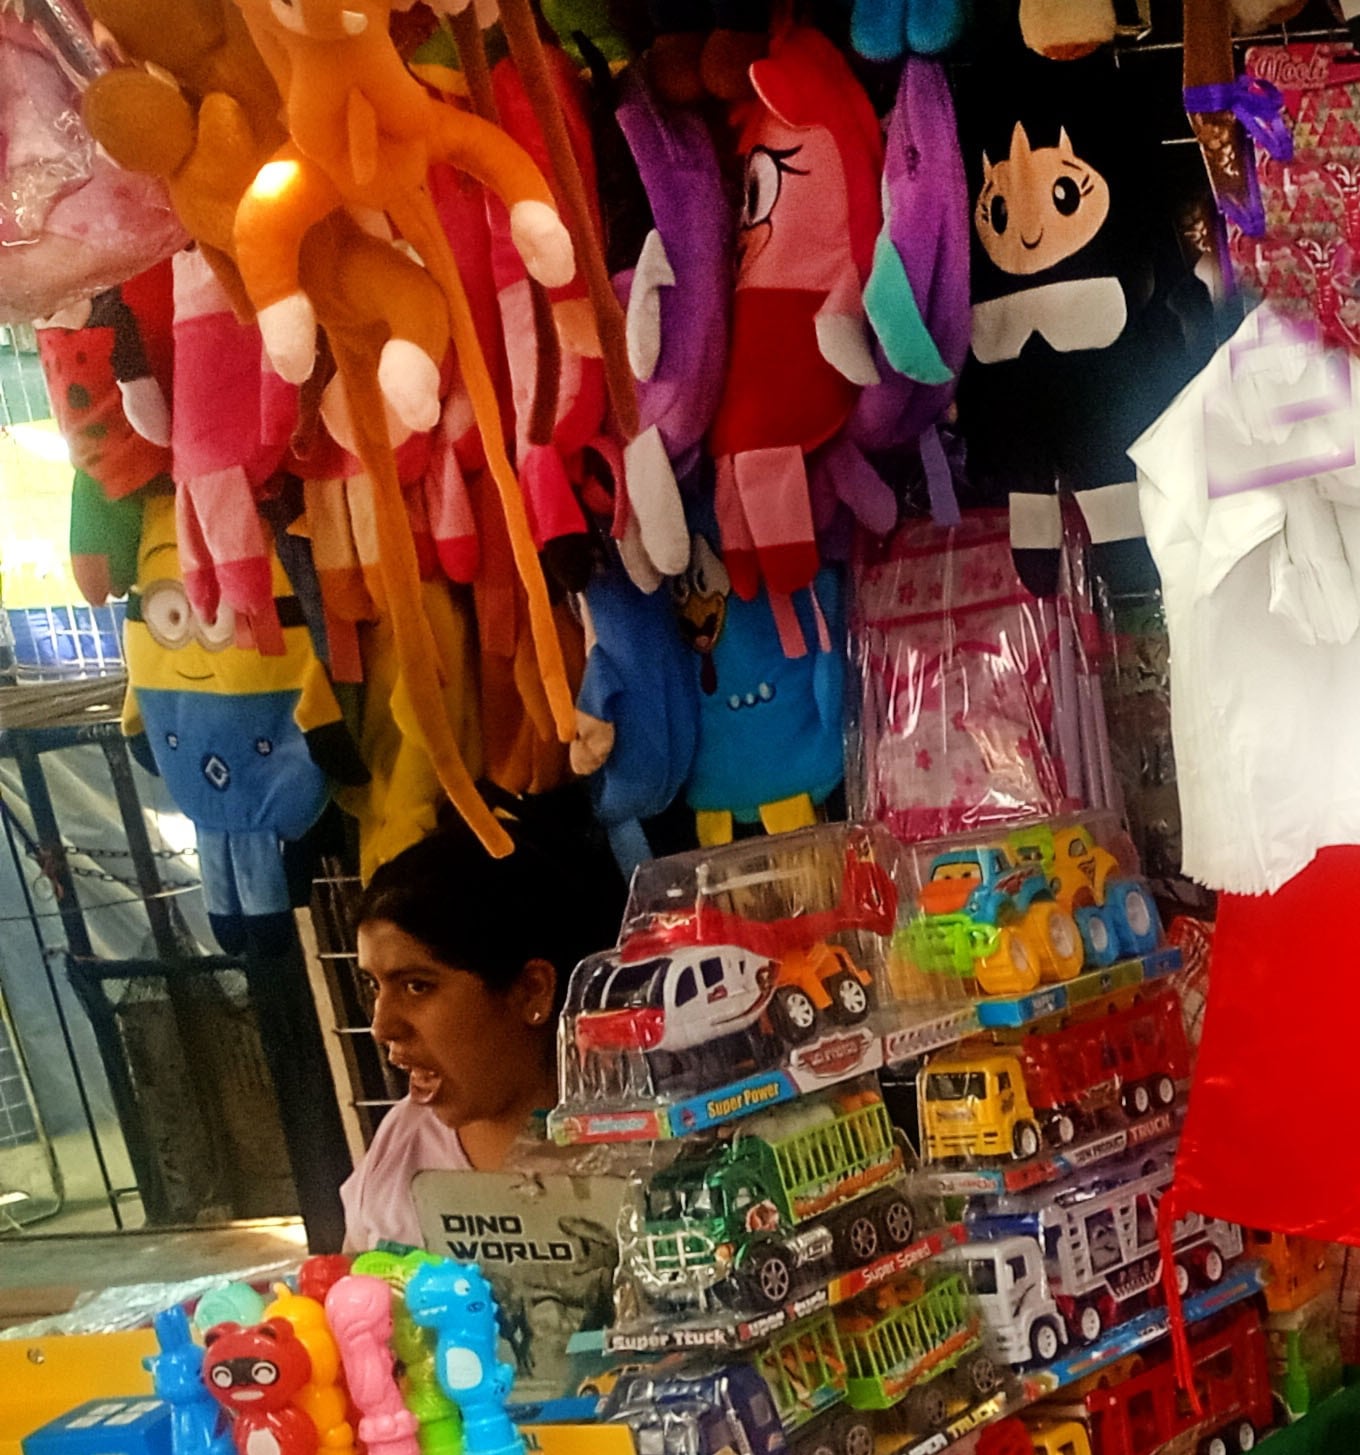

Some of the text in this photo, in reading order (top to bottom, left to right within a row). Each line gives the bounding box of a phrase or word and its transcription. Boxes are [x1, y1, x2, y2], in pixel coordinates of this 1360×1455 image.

[707, 1082, 780, 1119] Super Power
[440, 1214, 523, 1237] DINO
[447, 1241, 573, 1263] WORLD
[862, 1245, 932, 1284] Super Speed
[946, 1400, 1000, 1438] TRUCK
